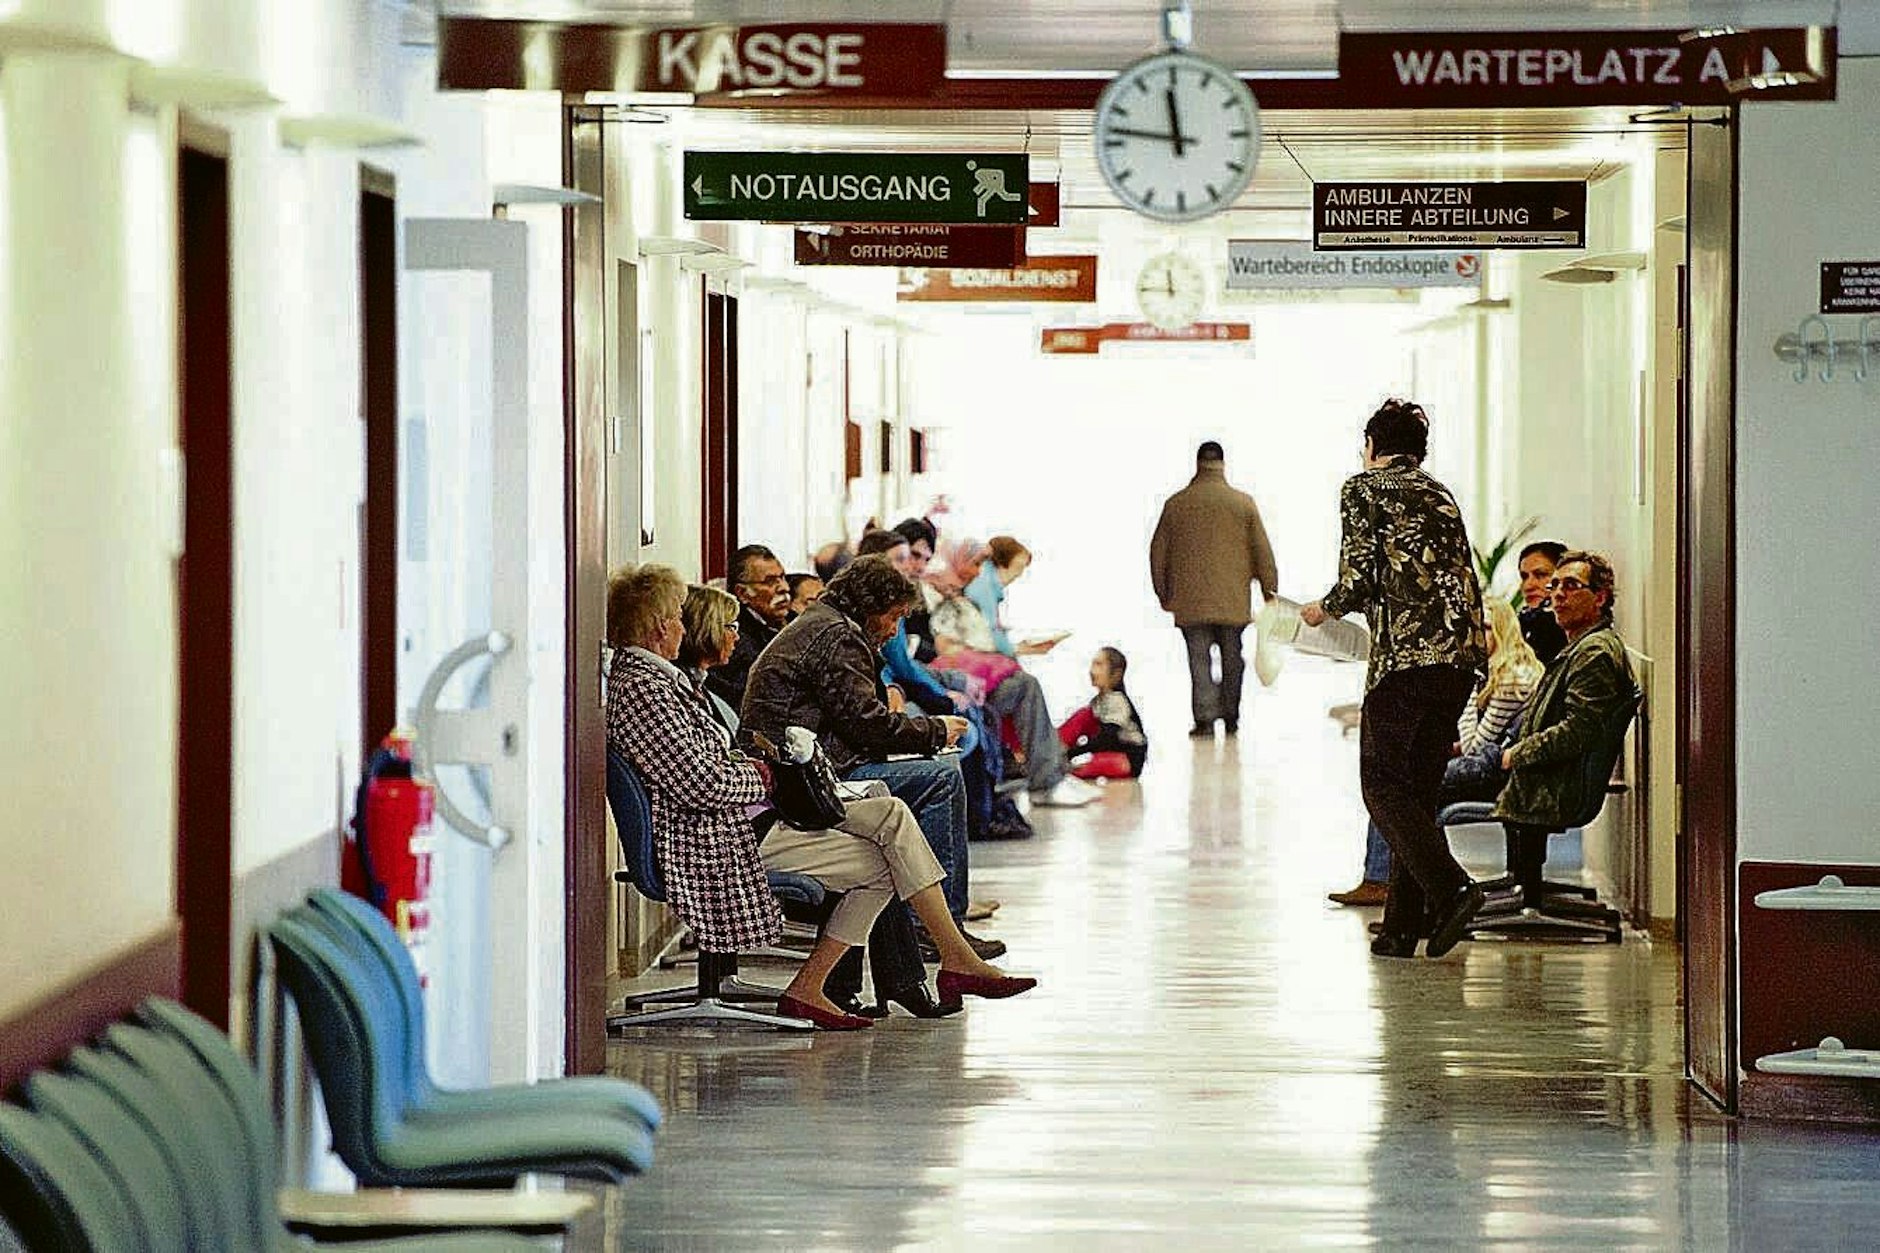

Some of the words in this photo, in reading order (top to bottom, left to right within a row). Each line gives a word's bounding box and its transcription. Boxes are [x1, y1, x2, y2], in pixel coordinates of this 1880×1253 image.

[658, 31, 865, 88] KASSE
[1392, 47, 1682, 86] WARTEPLATZ
[1700, 46, 1730, 84] A
[730, 173, 951, 201] NOTAUSGANG
[1324, 187, 1472, 206] AMBULANZEN
[1324, 208, 1403, 226] INNERE
[1410, 207, 1529, 226] ABTEILUNG
[850, 242, 949, 259] ORTHOPÄDIE
[1231, 255, 1346, 275] Wartebereich
[1351, 255, 1449, 278] Endoskopie
